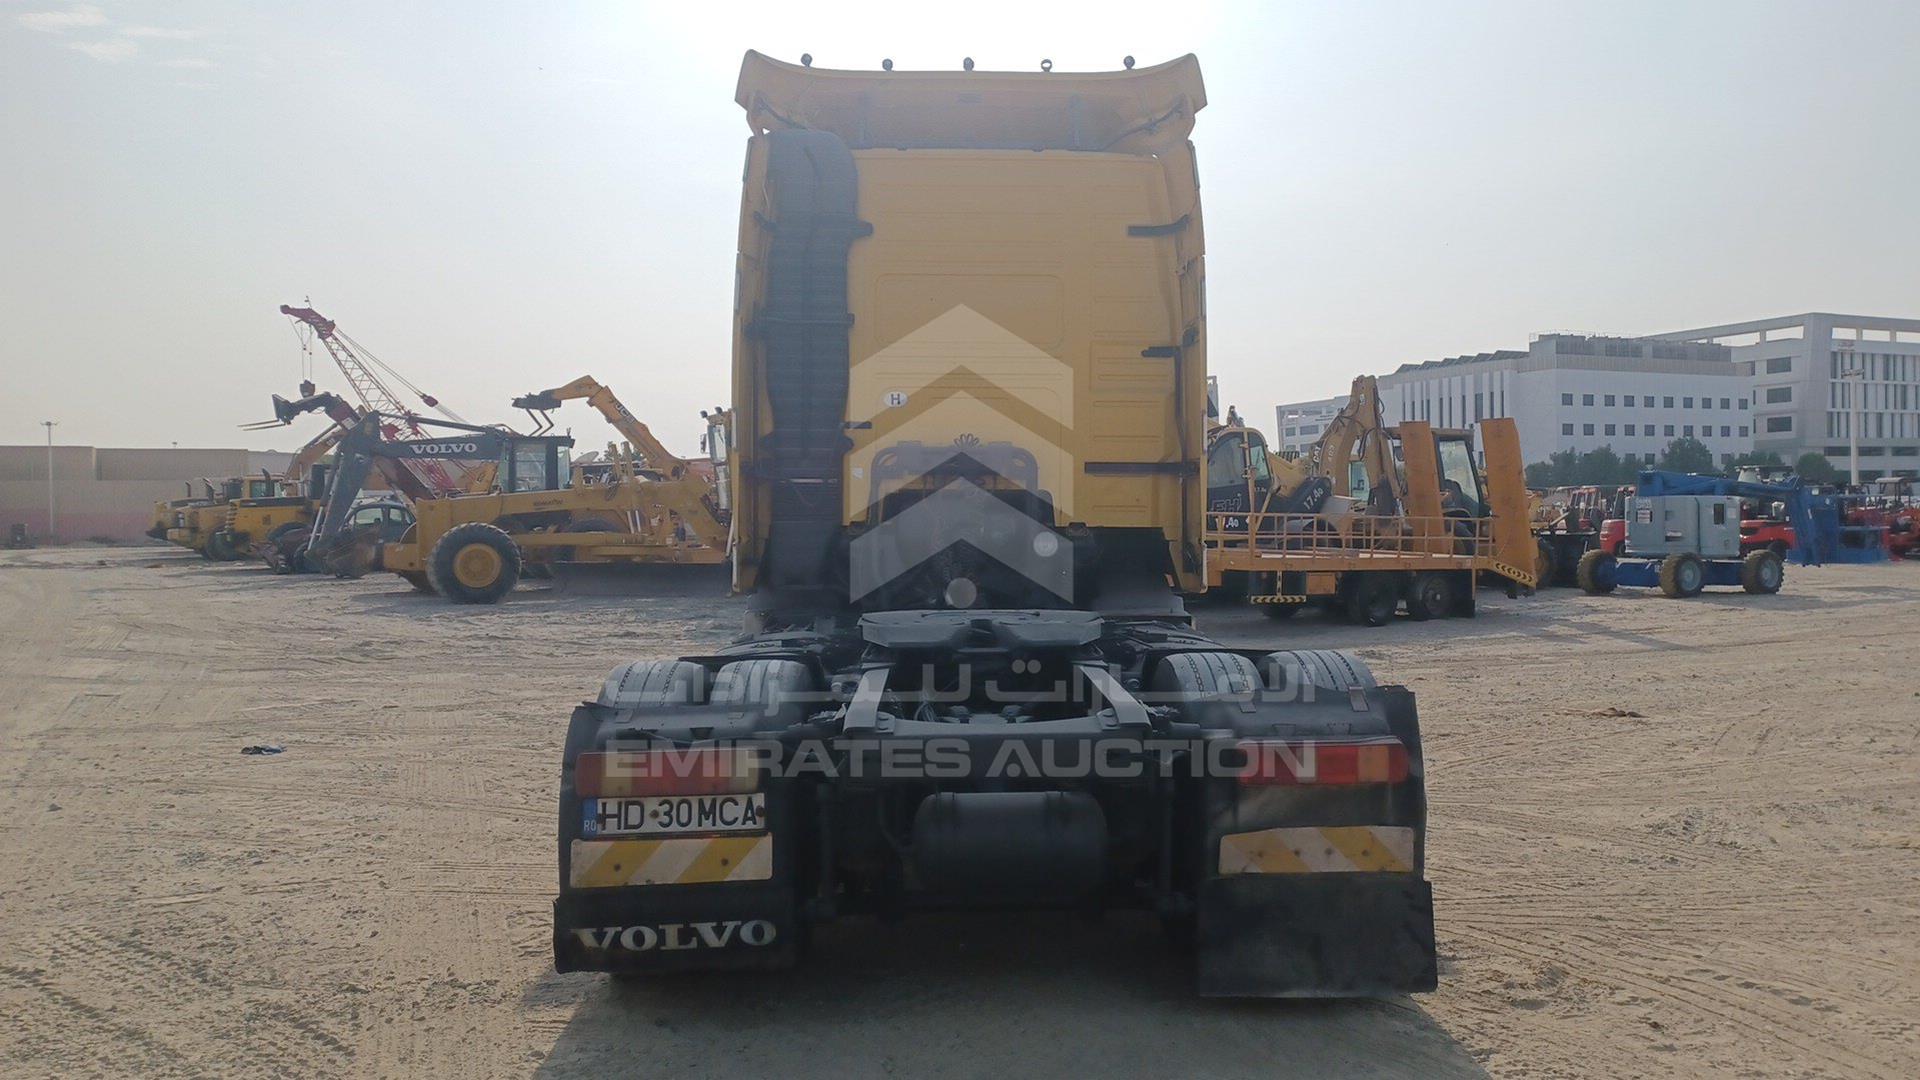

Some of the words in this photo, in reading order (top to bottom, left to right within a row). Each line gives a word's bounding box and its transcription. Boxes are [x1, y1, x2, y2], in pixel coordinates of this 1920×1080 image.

[890, 393, 900, 405] H
[410, 442, 477, 454] VOLVO
[583, 819, 597, 832] RO
[569, 919, 777, 951] VOLVO
